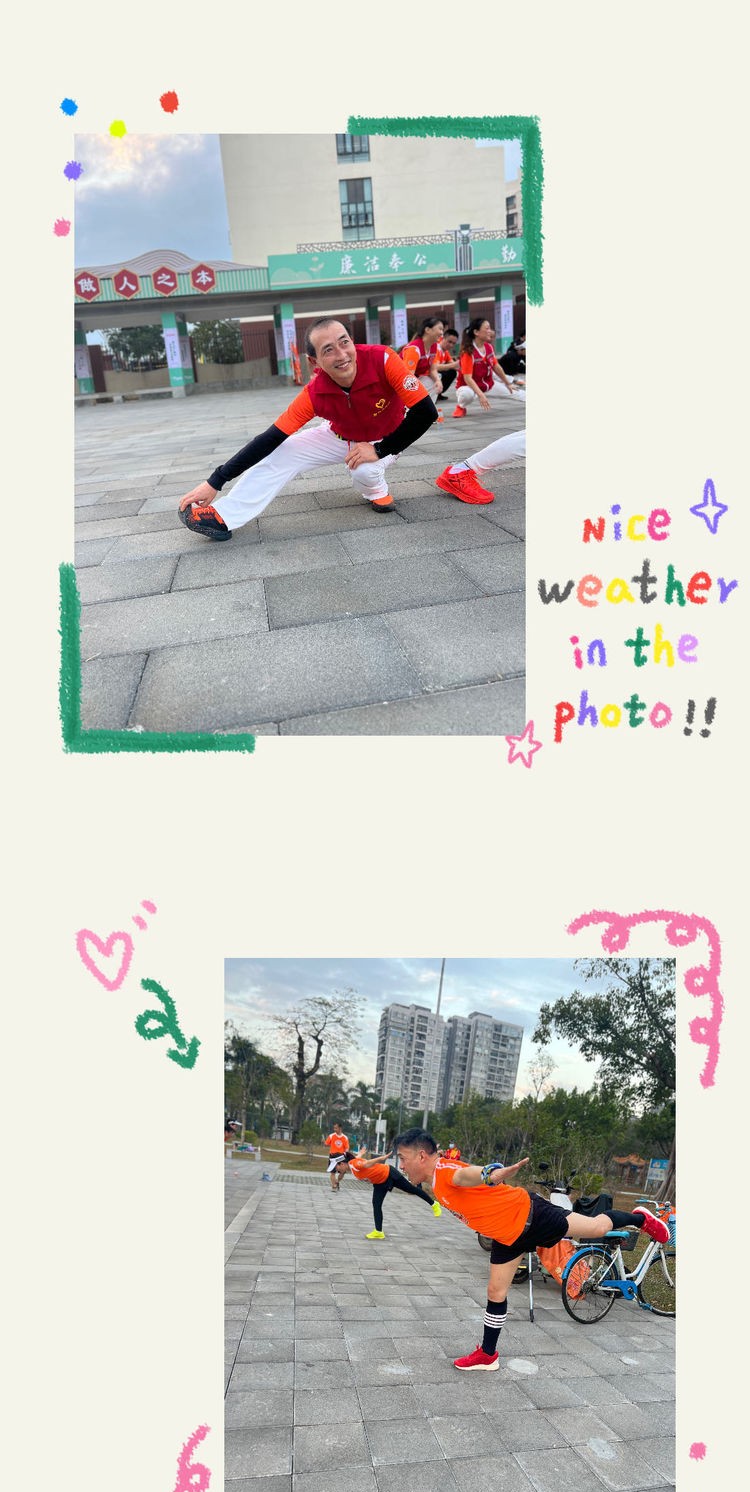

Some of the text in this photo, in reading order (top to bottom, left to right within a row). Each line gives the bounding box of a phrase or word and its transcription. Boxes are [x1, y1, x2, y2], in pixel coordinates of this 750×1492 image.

[339, 252, 427, 275] 廉洁奉公
[77, 269, 212, 293] 做人之本
